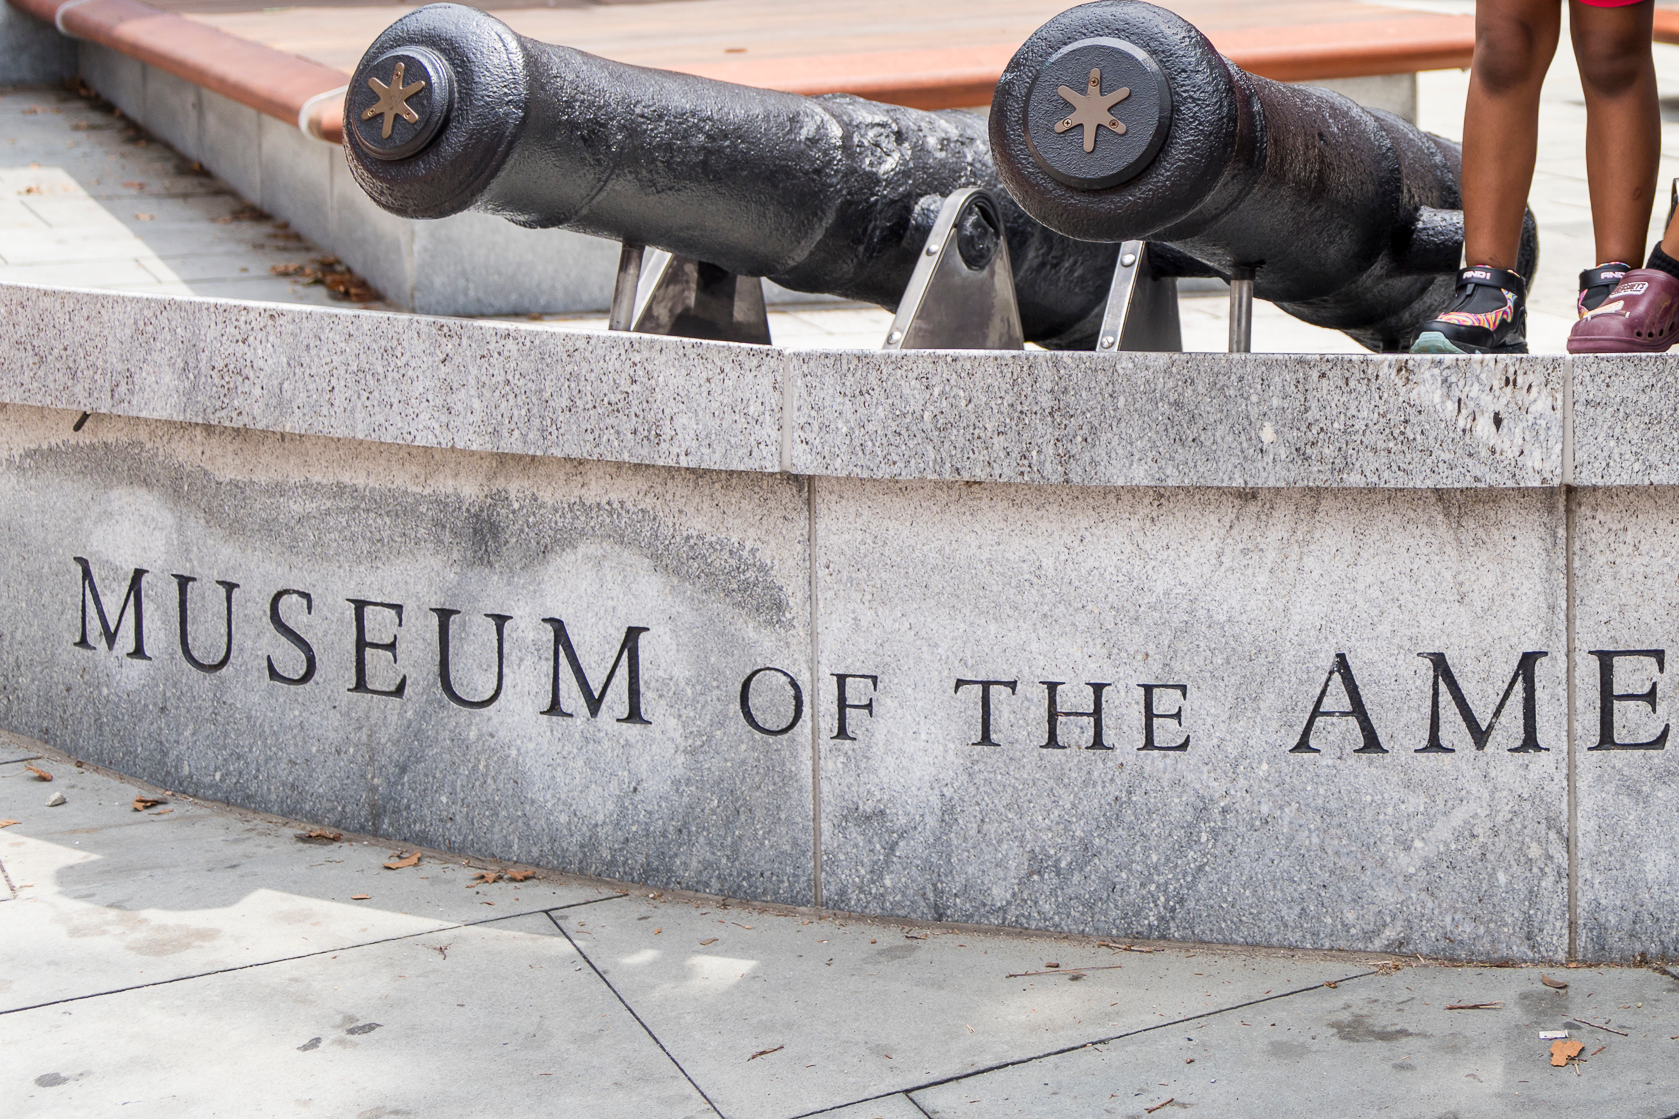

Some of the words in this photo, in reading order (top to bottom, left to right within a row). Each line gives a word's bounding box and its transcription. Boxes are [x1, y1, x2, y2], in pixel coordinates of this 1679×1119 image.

[73, 556, 653, 725] MUSEUM
[739, 666, 879, 741] OF
[953, 678, 1191, 752] THE
